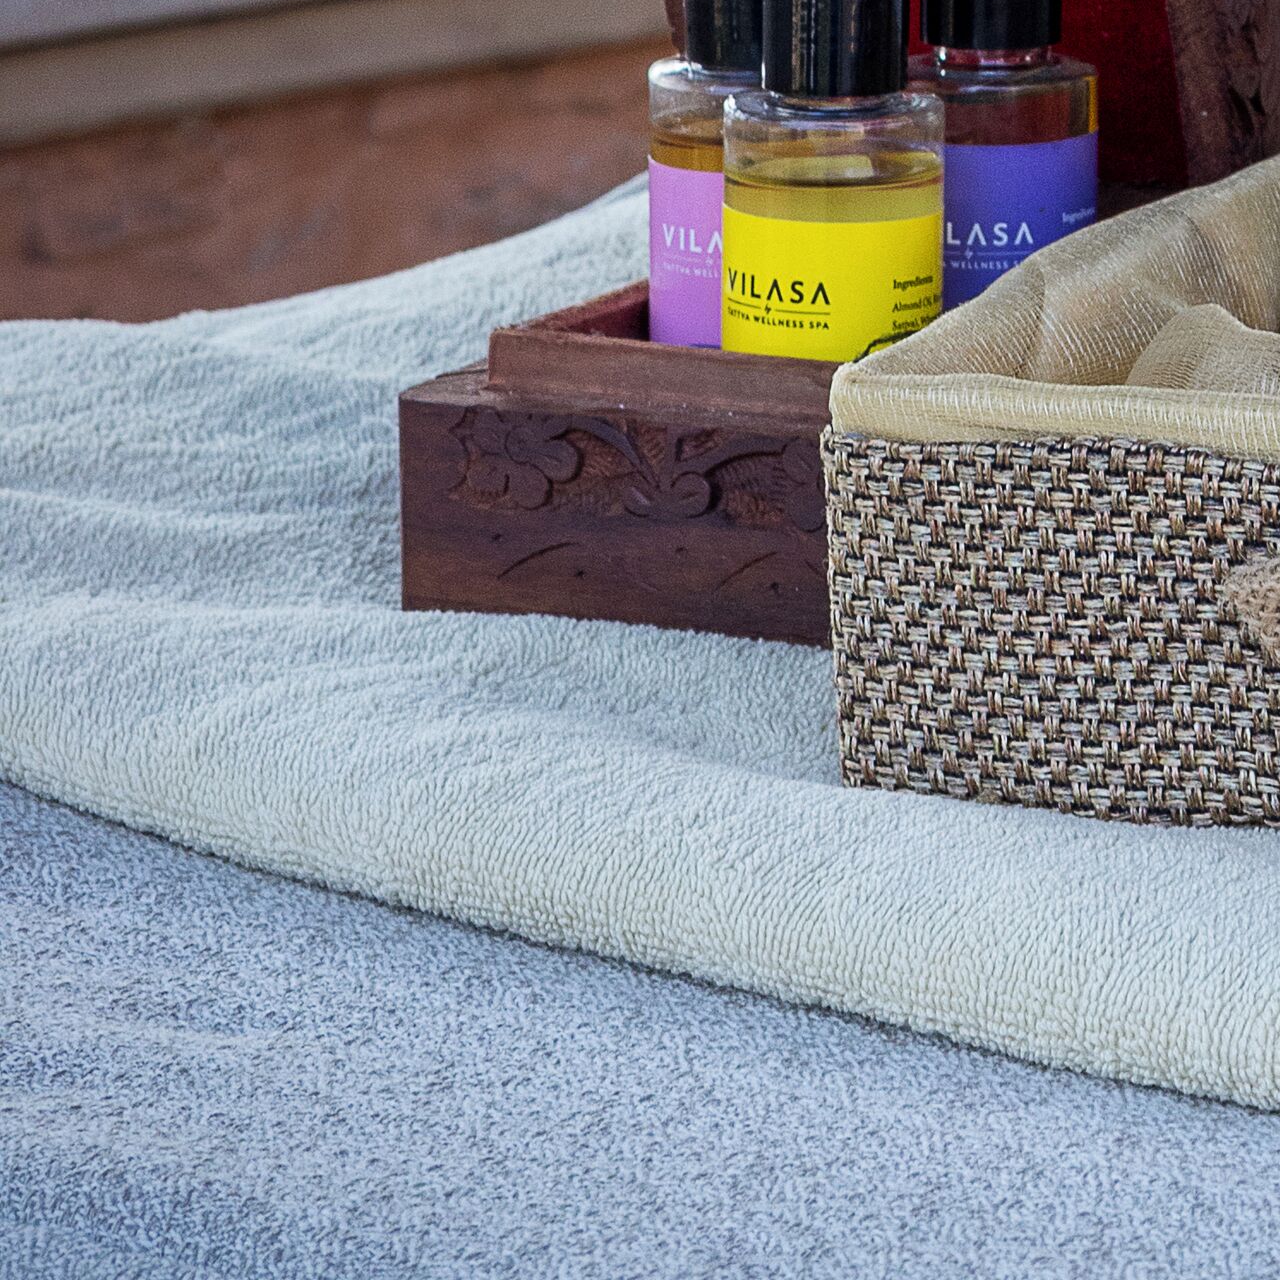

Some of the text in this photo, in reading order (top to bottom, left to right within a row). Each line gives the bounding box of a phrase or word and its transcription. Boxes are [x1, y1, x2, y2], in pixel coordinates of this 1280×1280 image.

[951, 260, 1009, 270] WELLNESS
[728, 267, 831, 306] VILASA
[728, 306, 830, 330] TATTVA WELLNESS SPA
